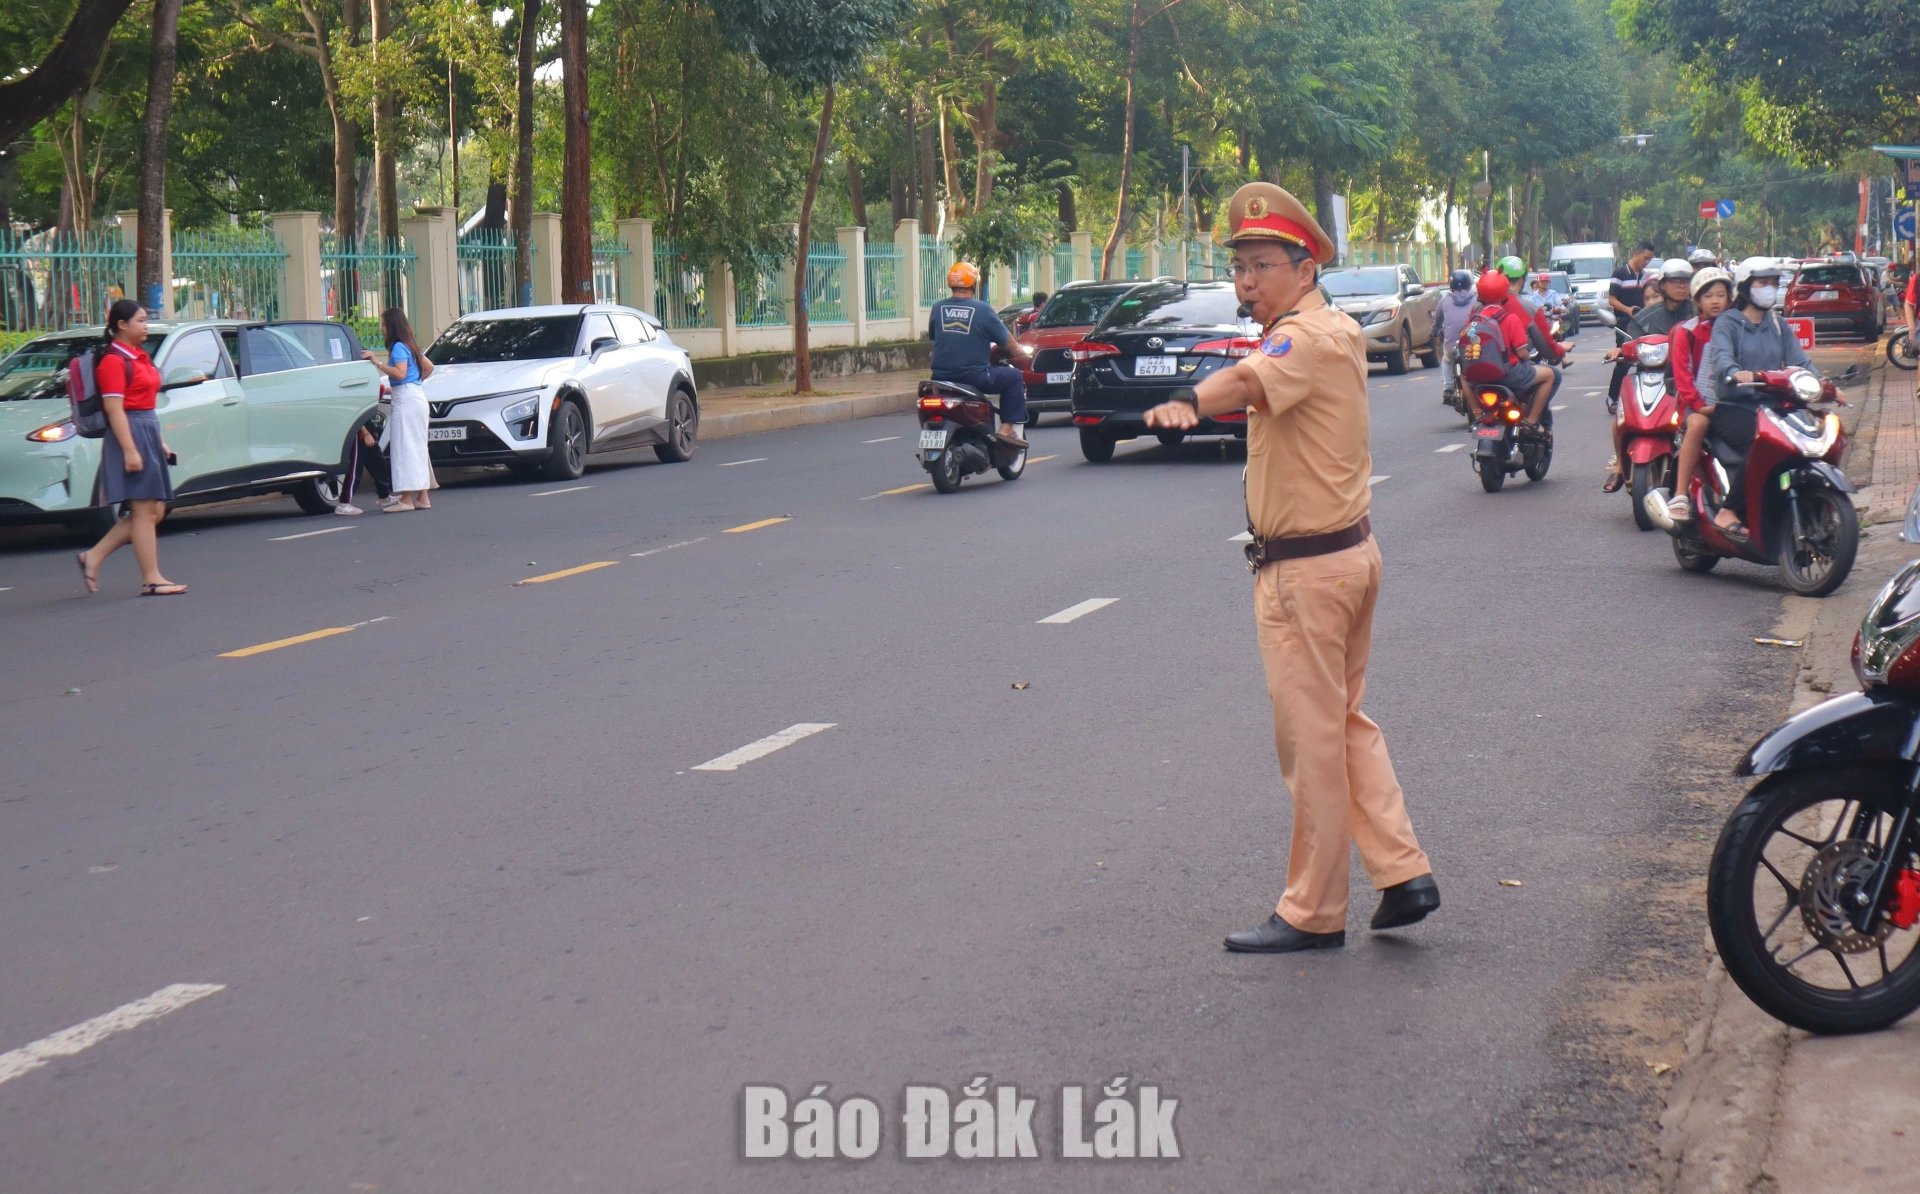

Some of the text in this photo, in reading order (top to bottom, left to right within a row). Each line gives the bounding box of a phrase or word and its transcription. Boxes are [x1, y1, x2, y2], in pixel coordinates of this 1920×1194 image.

[944, 308, 970, 319] VANS
[1148, 356, 1165, 365] 47A
[1140, 365, 1171, 374] 647.71
[1476, 428, 1499, 437] JVC
